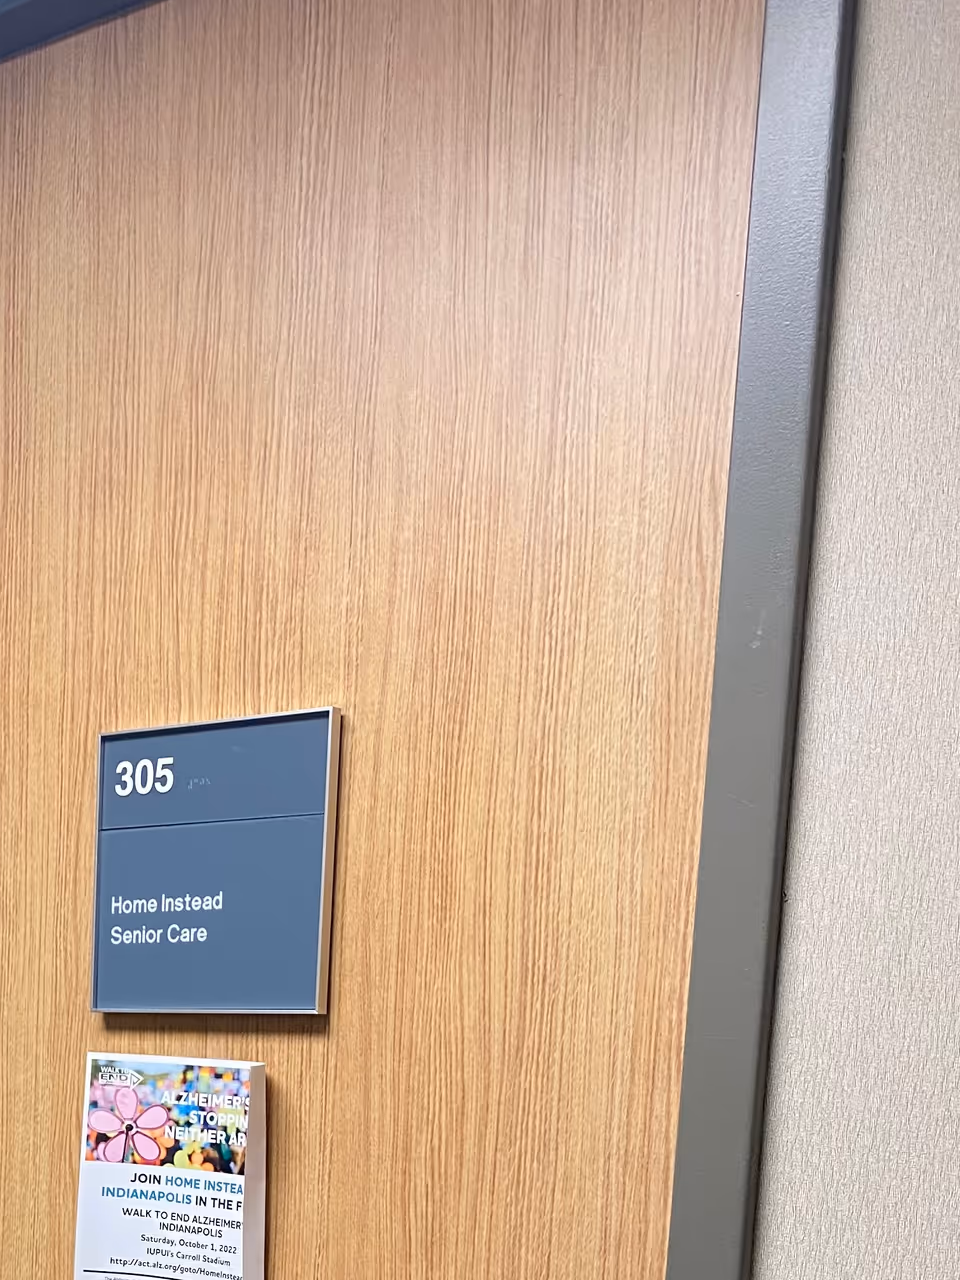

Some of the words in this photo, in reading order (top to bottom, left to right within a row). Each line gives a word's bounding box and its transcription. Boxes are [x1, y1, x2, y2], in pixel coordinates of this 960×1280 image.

[114, 756, 174, 796] 305
[111, 896, 158, 914] Home
[161, 891, 223, 913] Instead
[110, 925, 163, 944] Senior
[167, 924, 208, 943] Care
[164, 1126, 226, 1145] NEITHER
[130, 1173, 161, 1185] JOIN
[165, 1176, 200, 1190] HOME
[101, 1186, 192, 1205] INDIANAPOLIS
[195, 1195, 207, 1207] IN
[210, 1198, 232, 1210] THE
[122, 1207, 152, 1218] WALK
[155, 1210, 168, 1219] TO
[171, 1212, 190, 1222] END
[159, 1222, 223, 1238] INDIANAPOLIS
[140, 1234, 177, 1247] Saturday,
[178, 1239, 208, 1250] October
[219, 1244, 237, 1254] 2022
[176, 1251, 201, 1262] Carroll
[202, 1254, 231, 1266] Stadium
